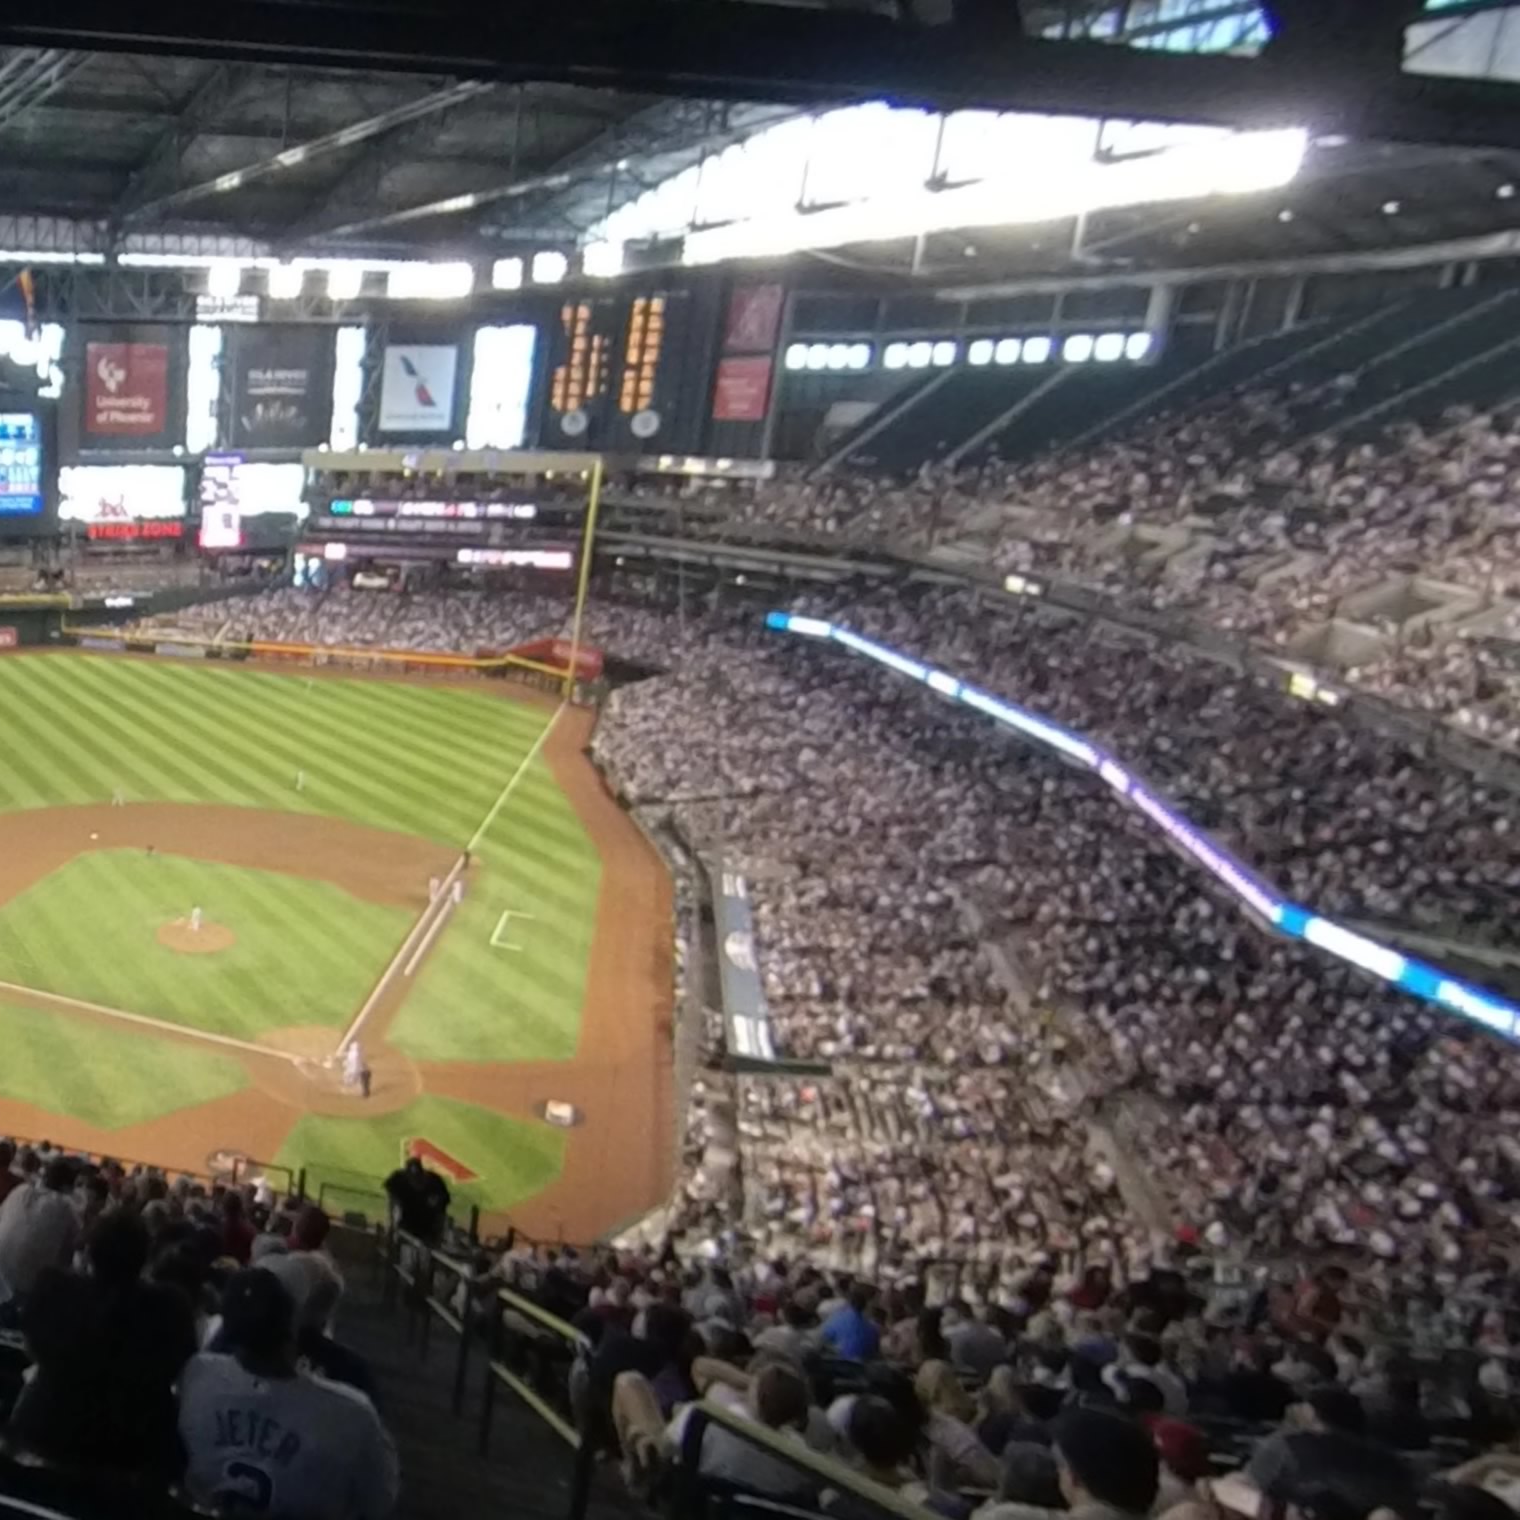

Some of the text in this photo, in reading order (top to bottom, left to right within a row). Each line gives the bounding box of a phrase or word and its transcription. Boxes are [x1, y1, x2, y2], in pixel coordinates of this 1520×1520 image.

[96, 395, 150, 411] University
[88, 520, 182, 540] STRIKE ZONE
[214, 1409, 302, 1468] JETER
[212, 1461, 273, 1519] 2
